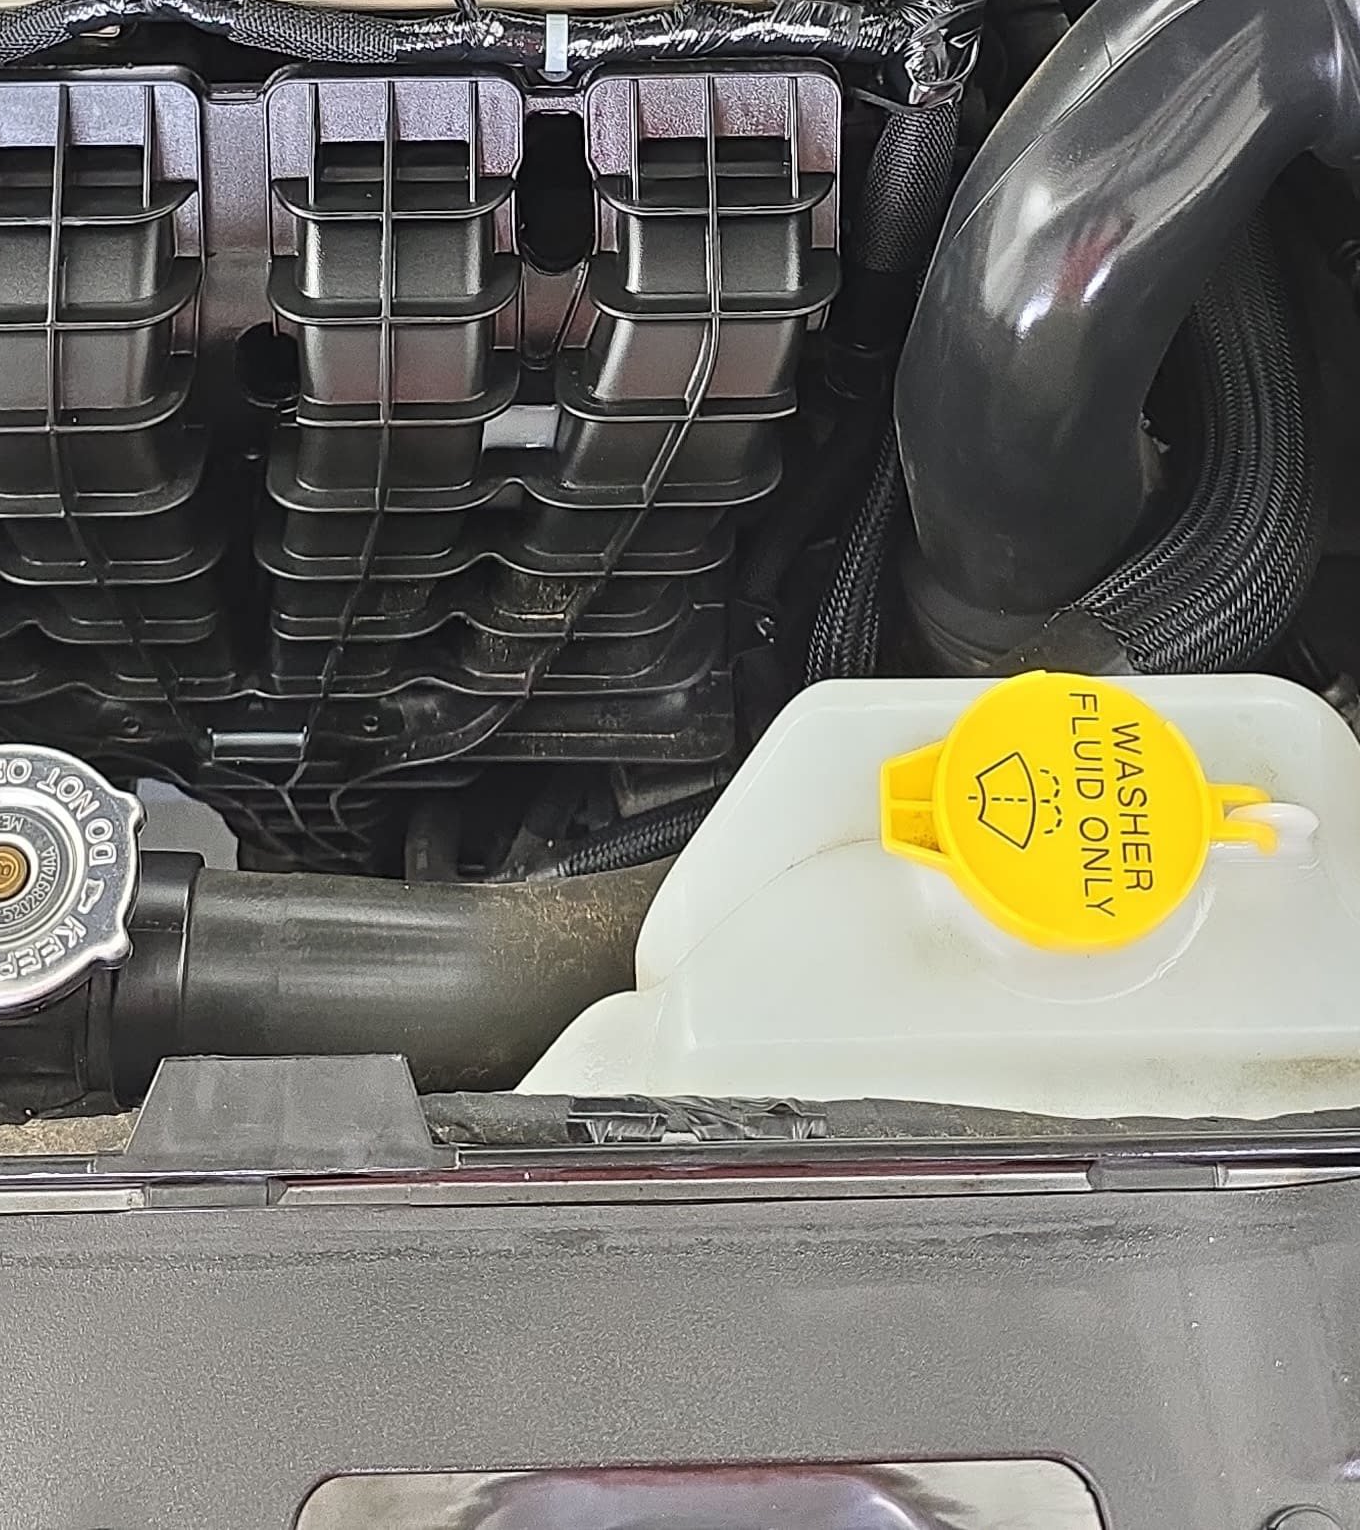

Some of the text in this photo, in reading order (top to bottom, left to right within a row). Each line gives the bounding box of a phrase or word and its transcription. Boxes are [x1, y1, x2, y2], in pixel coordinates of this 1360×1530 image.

[37, 766, 100, 820] NOT
[85, 818, 117, 866] DO
[1069, 692, 1117, 918] FLUID ONLY
[1111, 721, 1154, 893] WASHER
